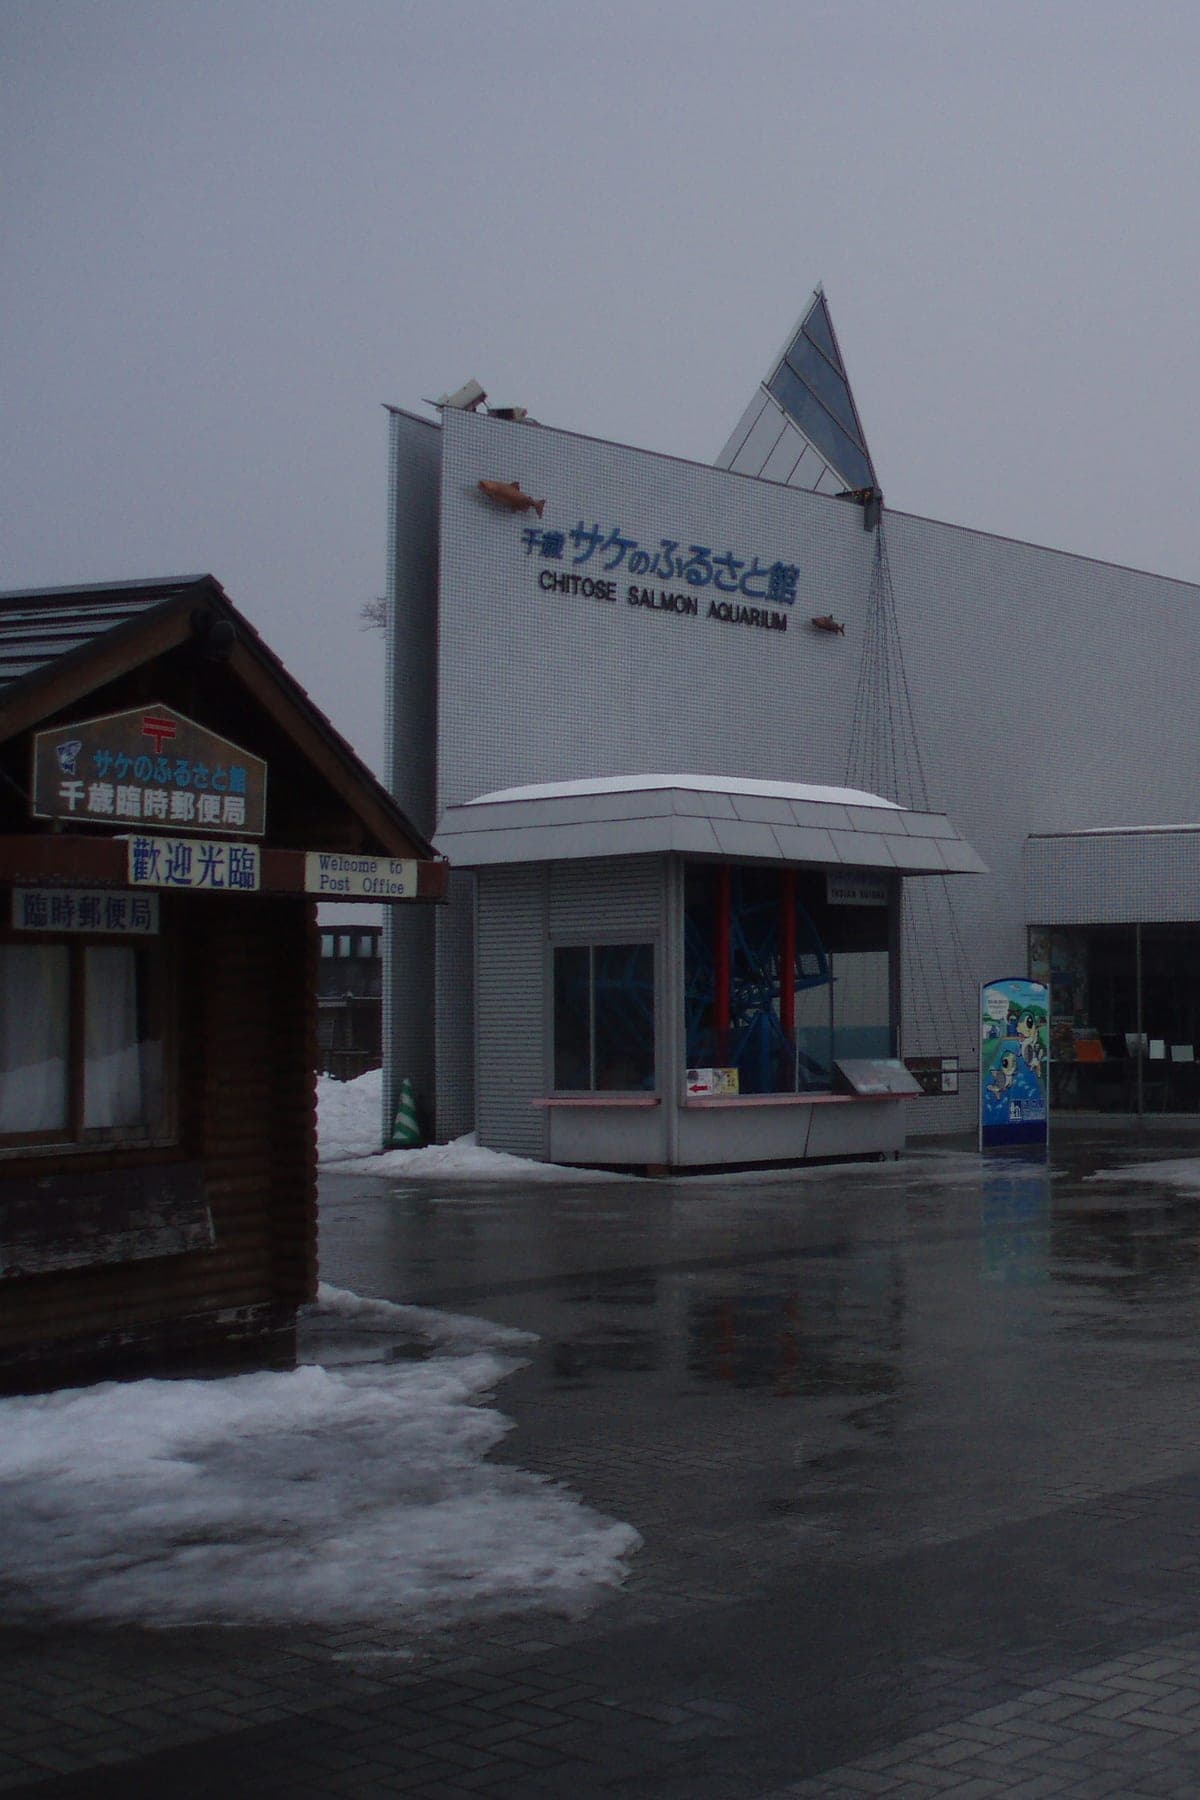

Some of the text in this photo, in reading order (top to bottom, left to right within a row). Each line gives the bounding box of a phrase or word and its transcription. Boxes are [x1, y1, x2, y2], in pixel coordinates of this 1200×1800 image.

[539, 569, 788, 632] CHITOSE SALMON AQUARIUM
[58, 780, 246, 826] 千歳臨時郵便局
[320, 855, 403, 874] Welcome to
[320, 874, 404, 894] Post Office
[23, 893, 151, 930] 臨時郵便局
